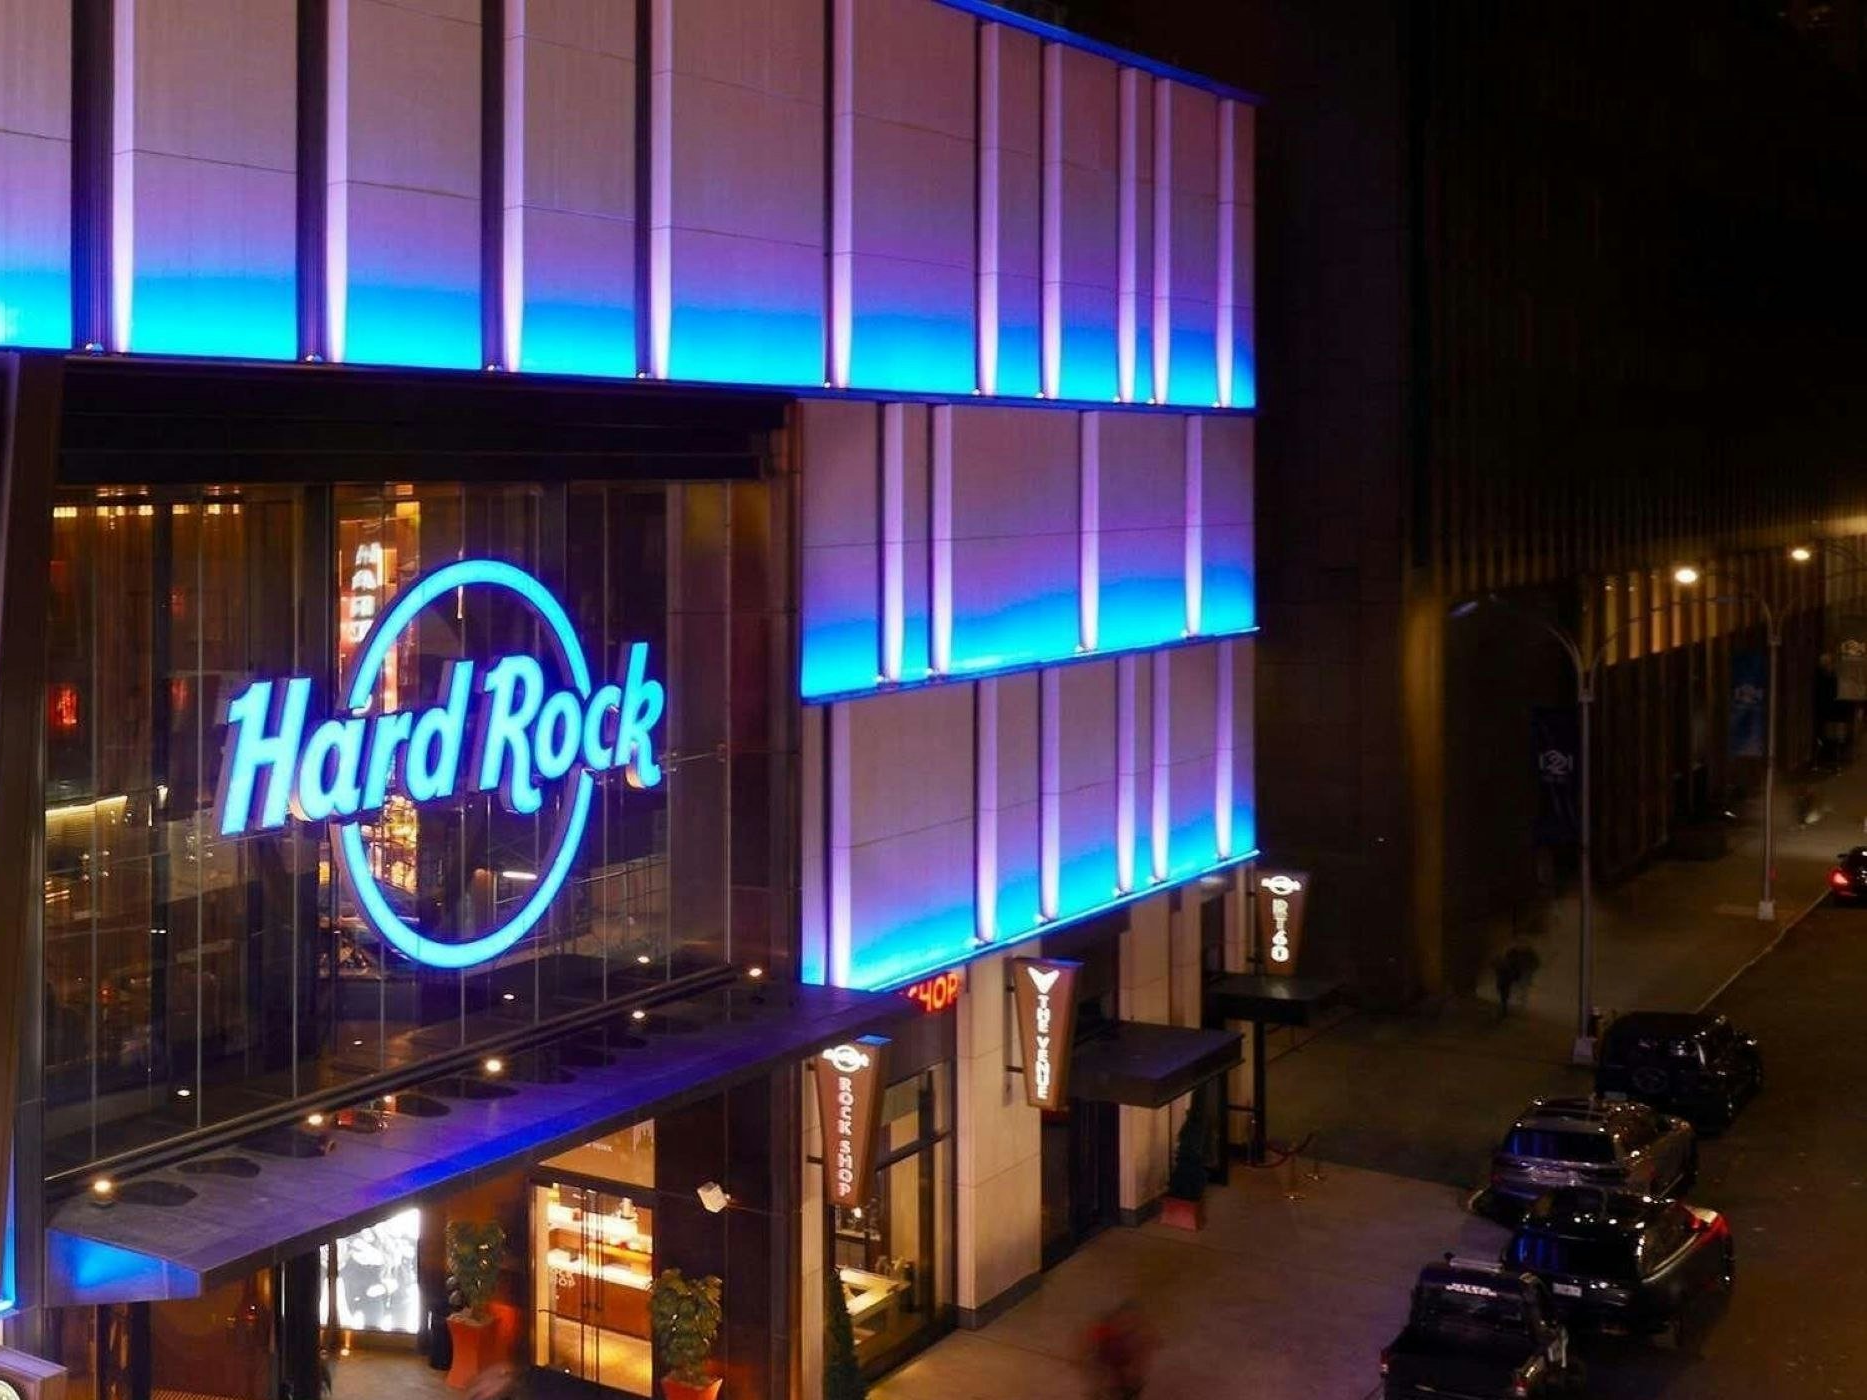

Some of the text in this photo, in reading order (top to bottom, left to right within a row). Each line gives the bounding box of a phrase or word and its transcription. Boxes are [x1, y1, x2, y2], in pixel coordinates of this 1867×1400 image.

[221, 642, 664, 836] Hard Rock
[907, 973, 958, 1012] HOP
[1035, 994, 1051, 1100] THE VENUE
[837, 1077, 854, 1197] ROCK SHOP
